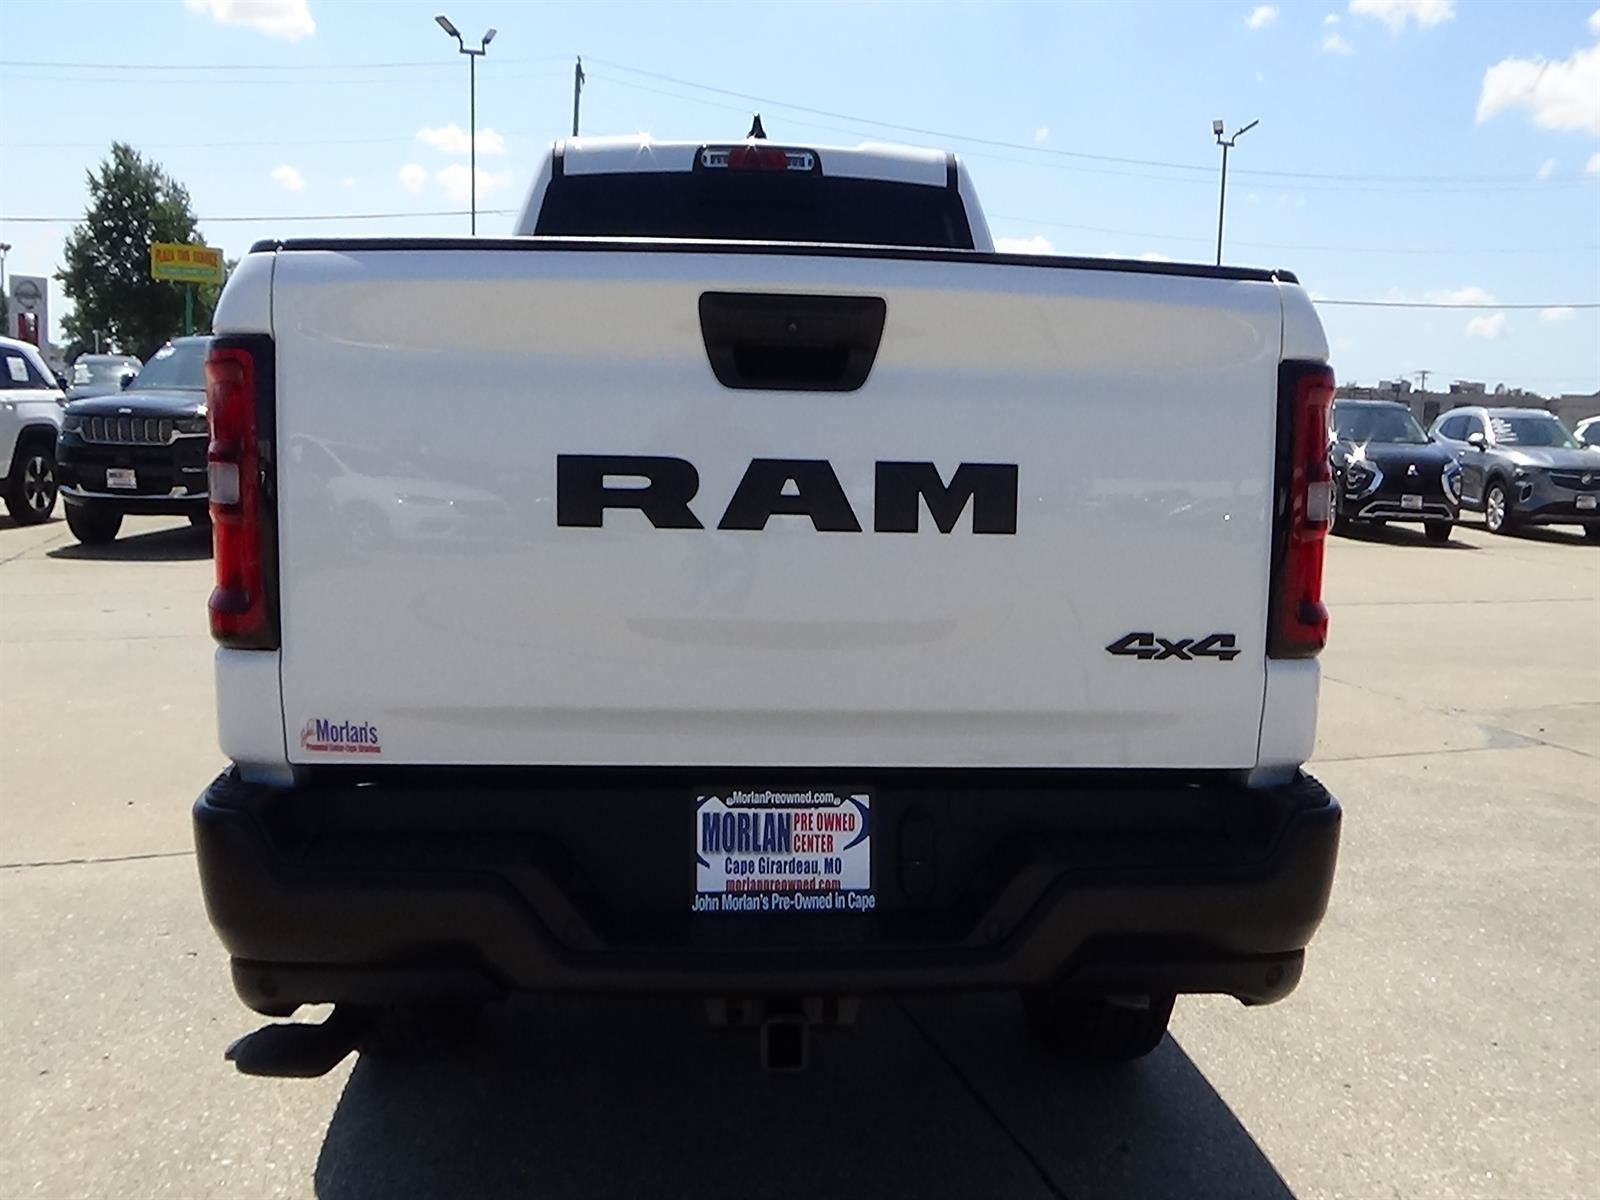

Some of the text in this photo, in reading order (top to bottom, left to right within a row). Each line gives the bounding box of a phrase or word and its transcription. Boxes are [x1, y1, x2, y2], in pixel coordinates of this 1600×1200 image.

[557, 454, 1018, 533] RAM
[1105, 633, 1241, 660] 4x4
[316, 719, 378, 743] Morlan's
[732, 791, 834, 806] MorlanPreowned.com
[794, 813, 855, 831] PRE OWNED
[702, 812, 791, 852] MORLAN
[793, 834, 833, 852] CENTER
[725, 857, 842, 876] Cape Girardeau, MO
[725, 877, 841, 891] morlanpreownedcom
[692, 894, 719, 911] John
[721, 894, 769, 911] Morlan's
[771, 893, 832, 911] Pre-Owned
[847, 892, 875, 912] Cape
